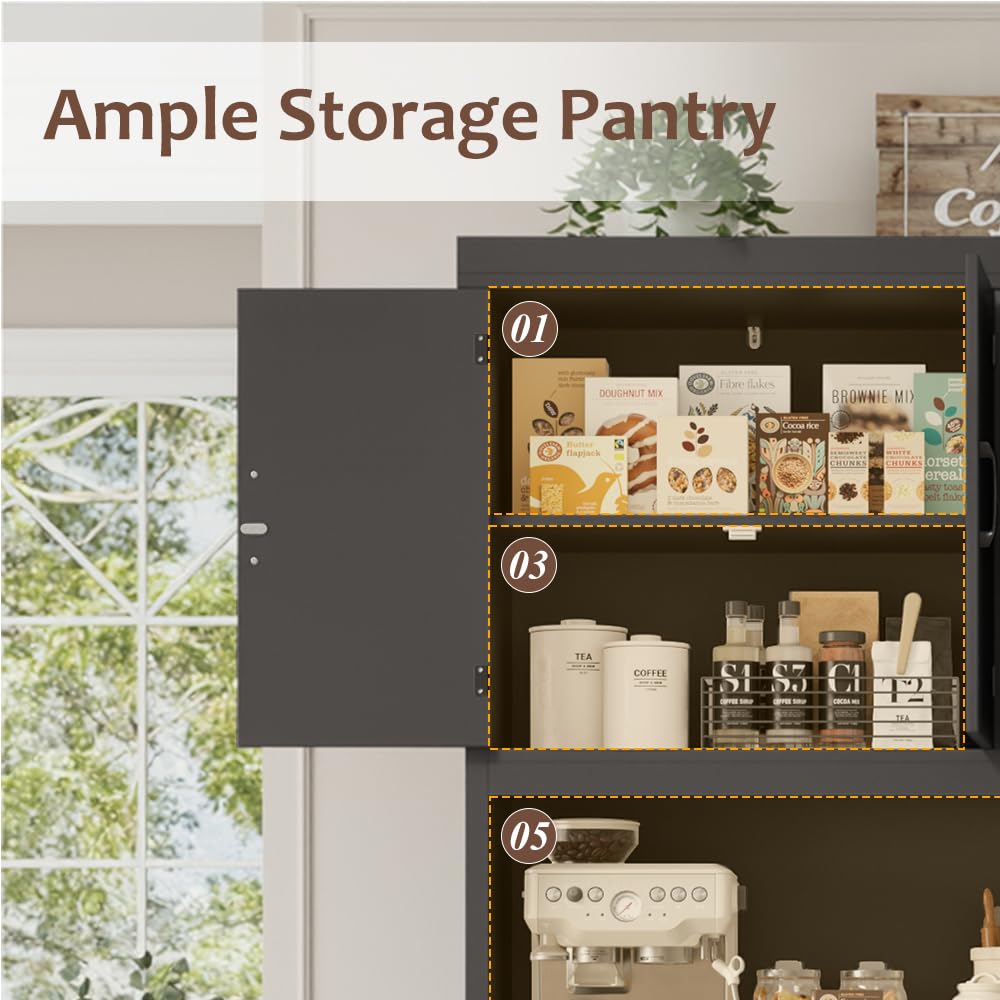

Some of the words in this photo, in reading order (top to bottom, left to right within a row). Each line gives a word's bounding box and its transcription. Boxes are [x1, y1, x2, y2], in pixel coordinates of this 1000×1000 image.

[719, 378, 745, 390] Fibre
[747, 378, 776, 390] flakes
[599, 388, 645, 399] DOUGHNUT
[648, 388, 665, 399] MIX
[831, 388, 888, 404] BROWNIE
[782, 421, 805, 430] Cocoa
[806, 420, 820, 430] rice
[566, 449, 601, 458] flapjack
[924, 455, 964, 468] orset
[575, 652, 593, 661] TEA
[633, 668, 668, 678] COFFEE
[895, 714, 911, 723] TEA
